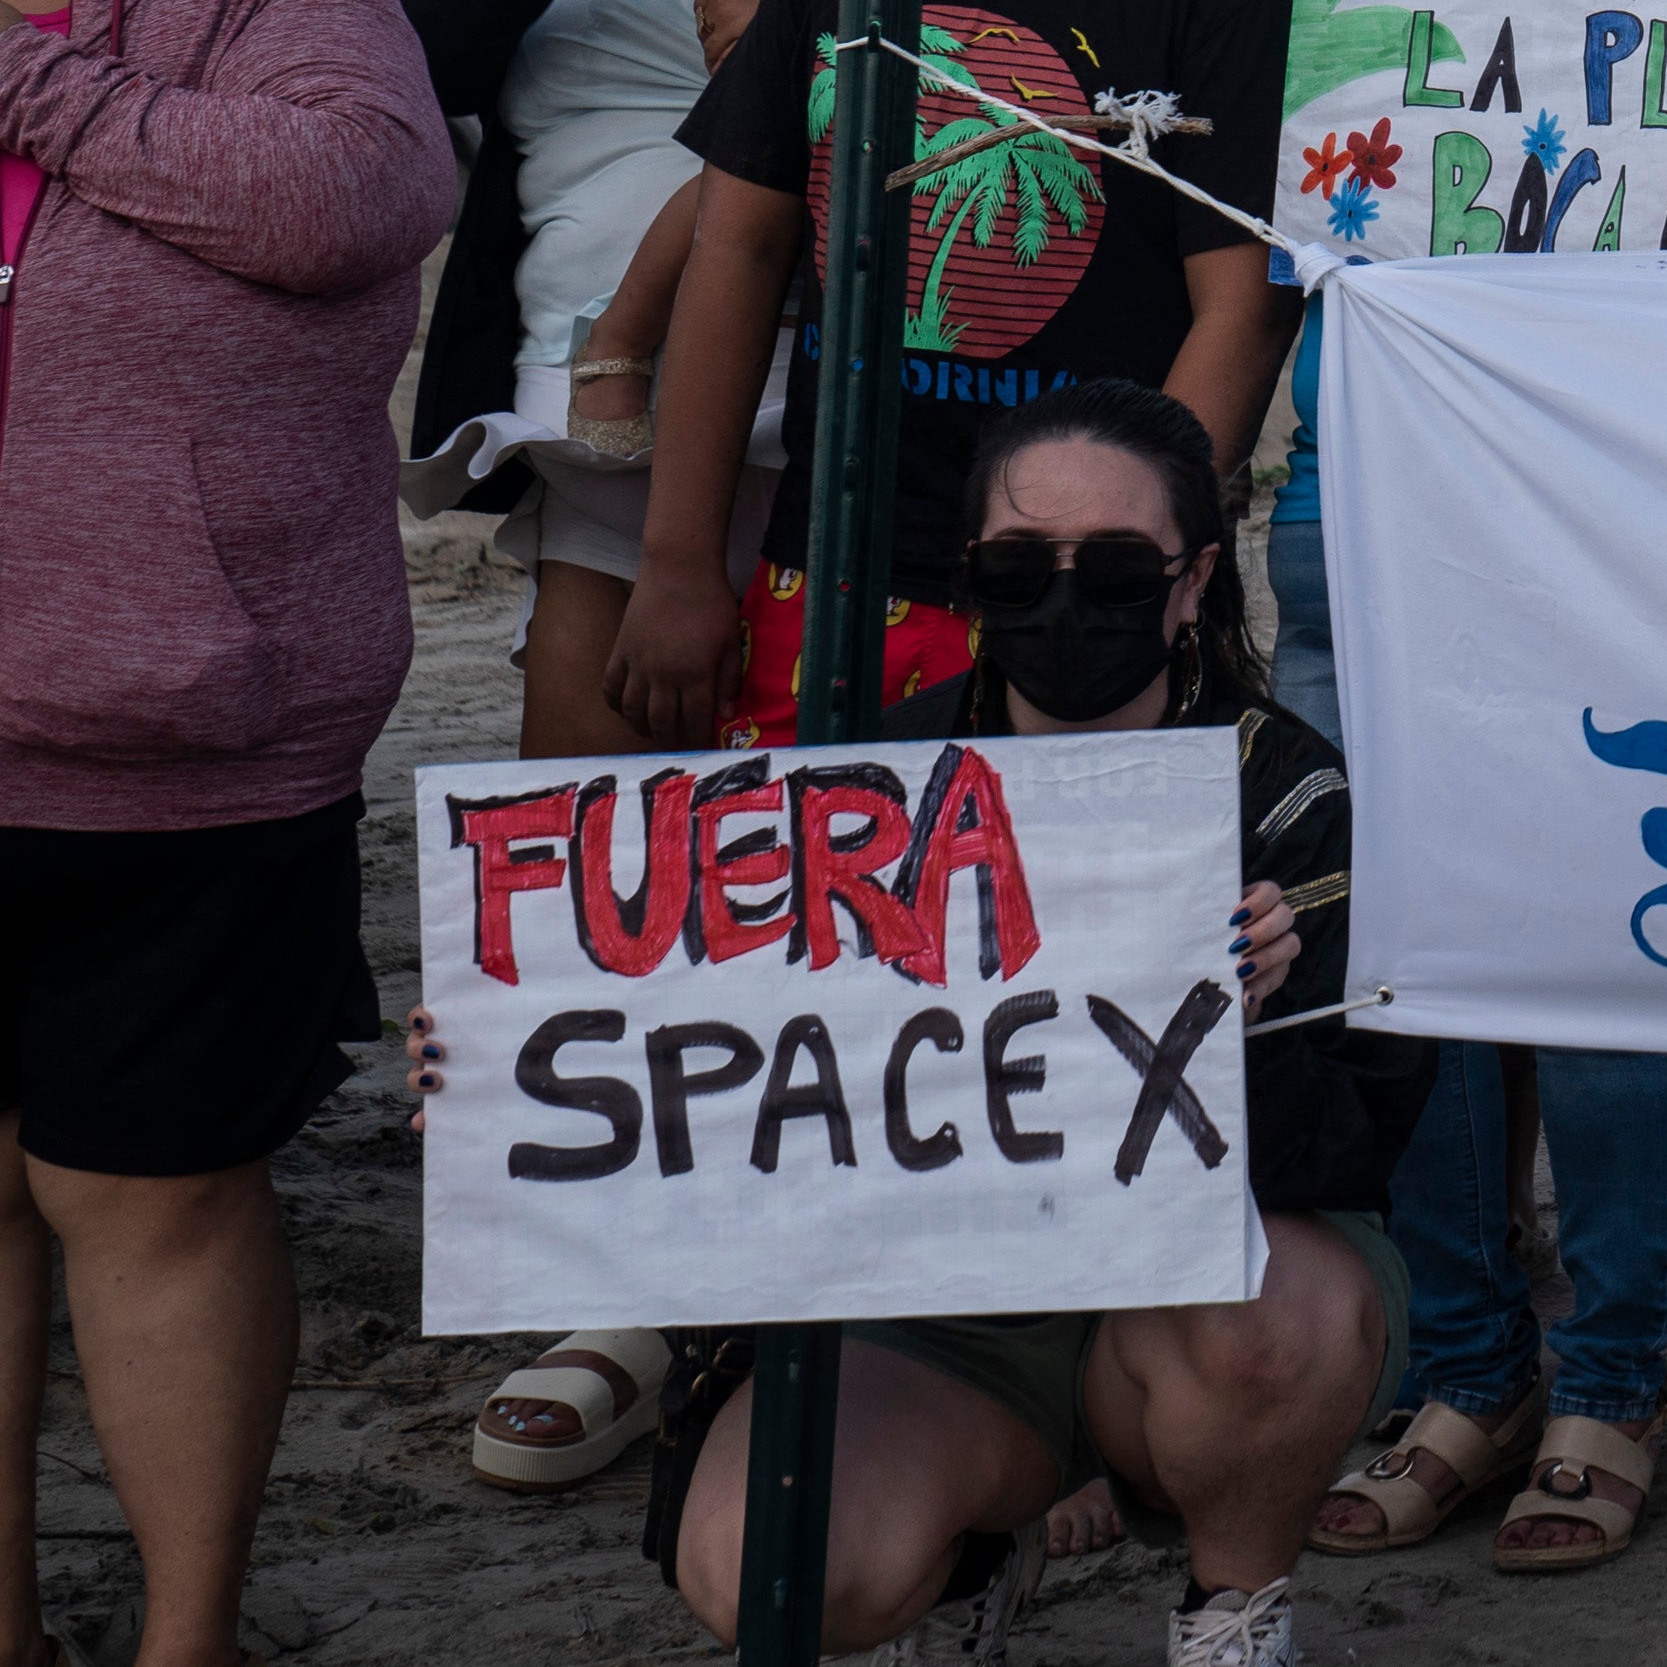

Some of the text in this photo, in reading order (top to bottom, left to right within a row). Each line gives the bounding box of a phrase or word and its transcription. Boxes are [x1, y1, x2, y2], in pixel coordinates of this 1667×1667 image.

[1402, 10, 1522, 113] LA
[1430, 131, 1624, 254] BOCA
[446, 742, 1041, 989] FUERA
[507, 978, 1233, 1186] SPACEX
